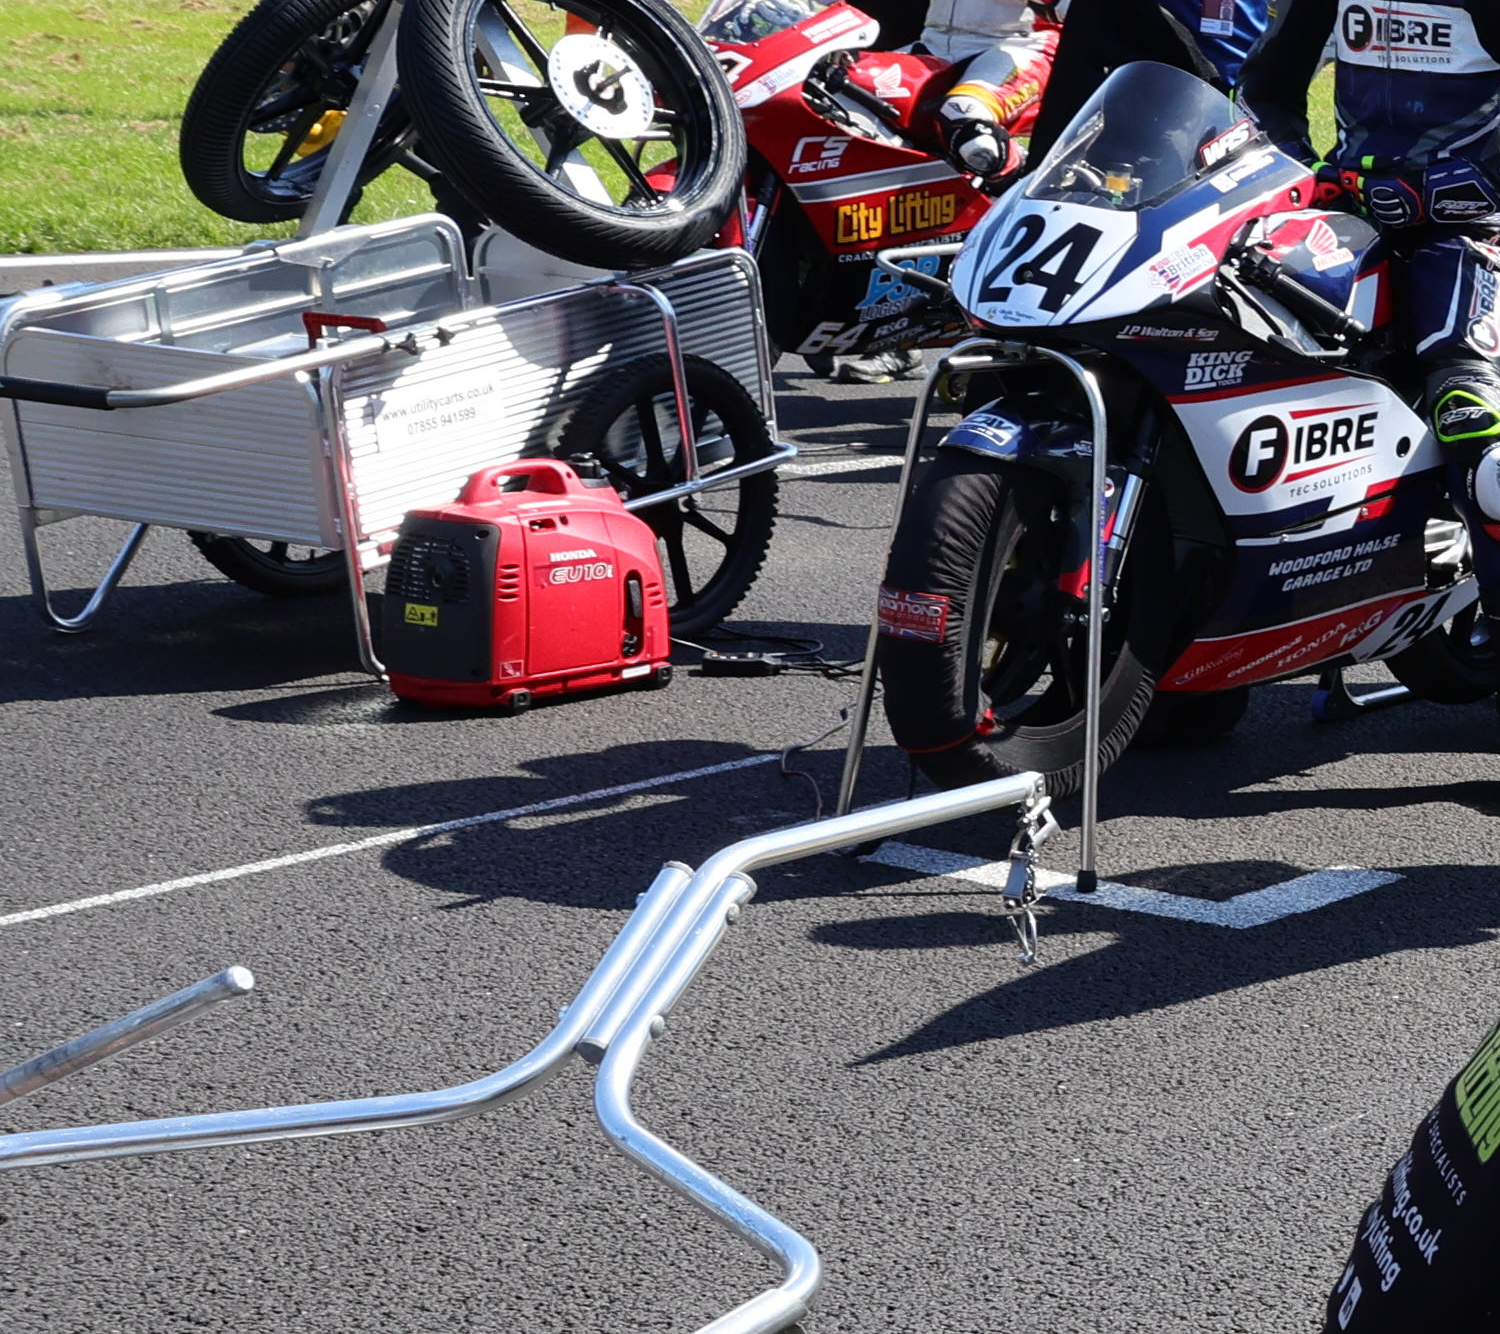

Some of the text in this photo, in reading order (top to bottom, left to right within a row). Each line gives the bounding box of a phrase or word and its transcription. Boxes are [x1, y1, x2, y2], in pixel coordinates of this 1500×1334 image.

[1343, 7, 1453, 50] FIBRE
[837, 191, 957, 245] City Lifting
[978, 213, 1104, 314] 24
[797, 321, 865, 355] 64
[1140, 325, 1184, 338] Walton
[1184, 364, 1246, 385] DICK
[1187, 351, 1253, 366] KING
[1241, 410, 1380, 480] FIBRE
[1289, 464, 1374, 498] TEC SOLUTIONS
[549, 548, 598, 563] HONDA
[1268, 533, 1402, 577] WOODFORD HALSE
[1281, 559, 1374, 593] GARAGE LTD
[1275, 620, 1348, 668] HONDA
[1369, 591, 1453, 659] 24
